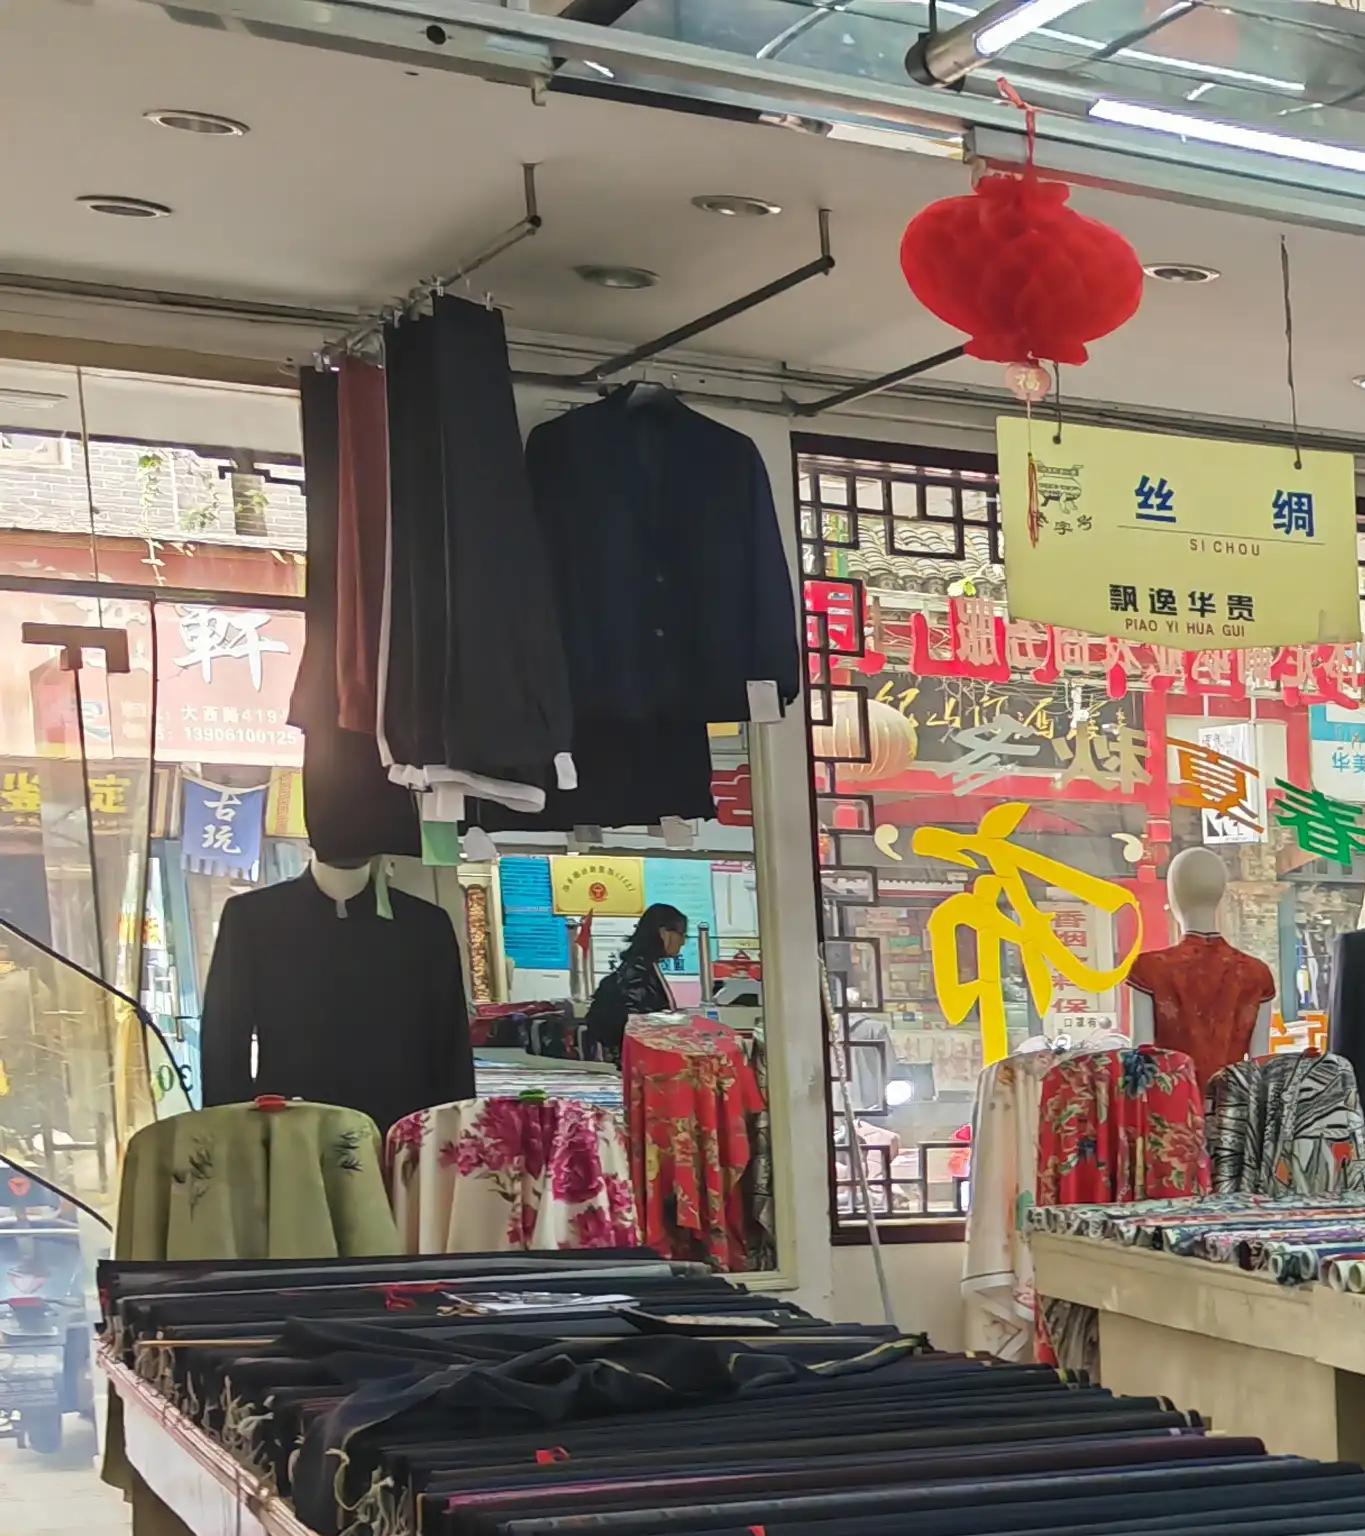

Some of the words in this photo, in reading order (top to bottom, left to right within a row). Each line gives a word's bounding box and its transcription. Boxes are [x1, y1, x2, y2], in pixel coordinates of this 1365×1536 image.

[1134, 474, 1315, 538] 丝绸
[1109, 583, 1256, 623] 飘逸华贵
[1124, 618, 1159, 633] PIAO
[1166, 620, 1179, 633] YI
[1186, 621, 1215, 636] HUA
[1221, 624, 1246, 638] GUI
[181, 704, 288, 725] 大西路419
[202, 790, 243, 856] 古玩
